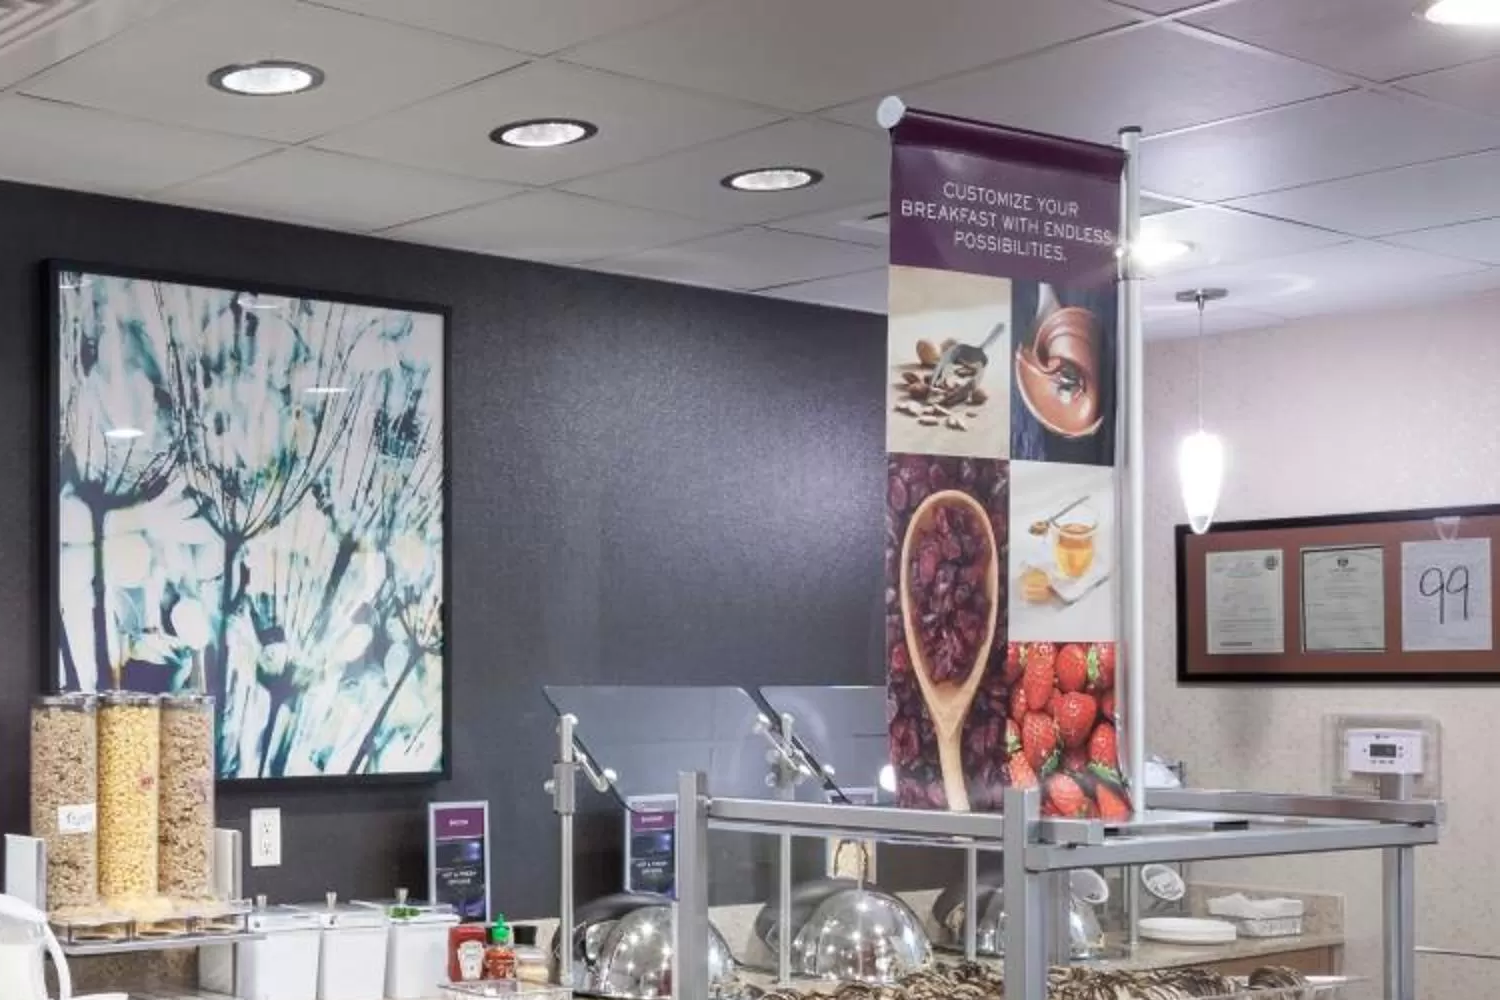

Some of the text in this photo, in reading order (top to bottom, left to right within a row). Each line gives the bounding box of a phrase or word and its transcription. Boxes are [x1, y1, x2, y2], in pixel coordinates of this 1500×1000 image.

[942, 181, 1080, 218] CUSTOMIZE YOUR
[901, 199, 1114, 245] BREAKFAST WITH ENDLESS
[954, 230, 1068, 262] POSSIBILITIES.
